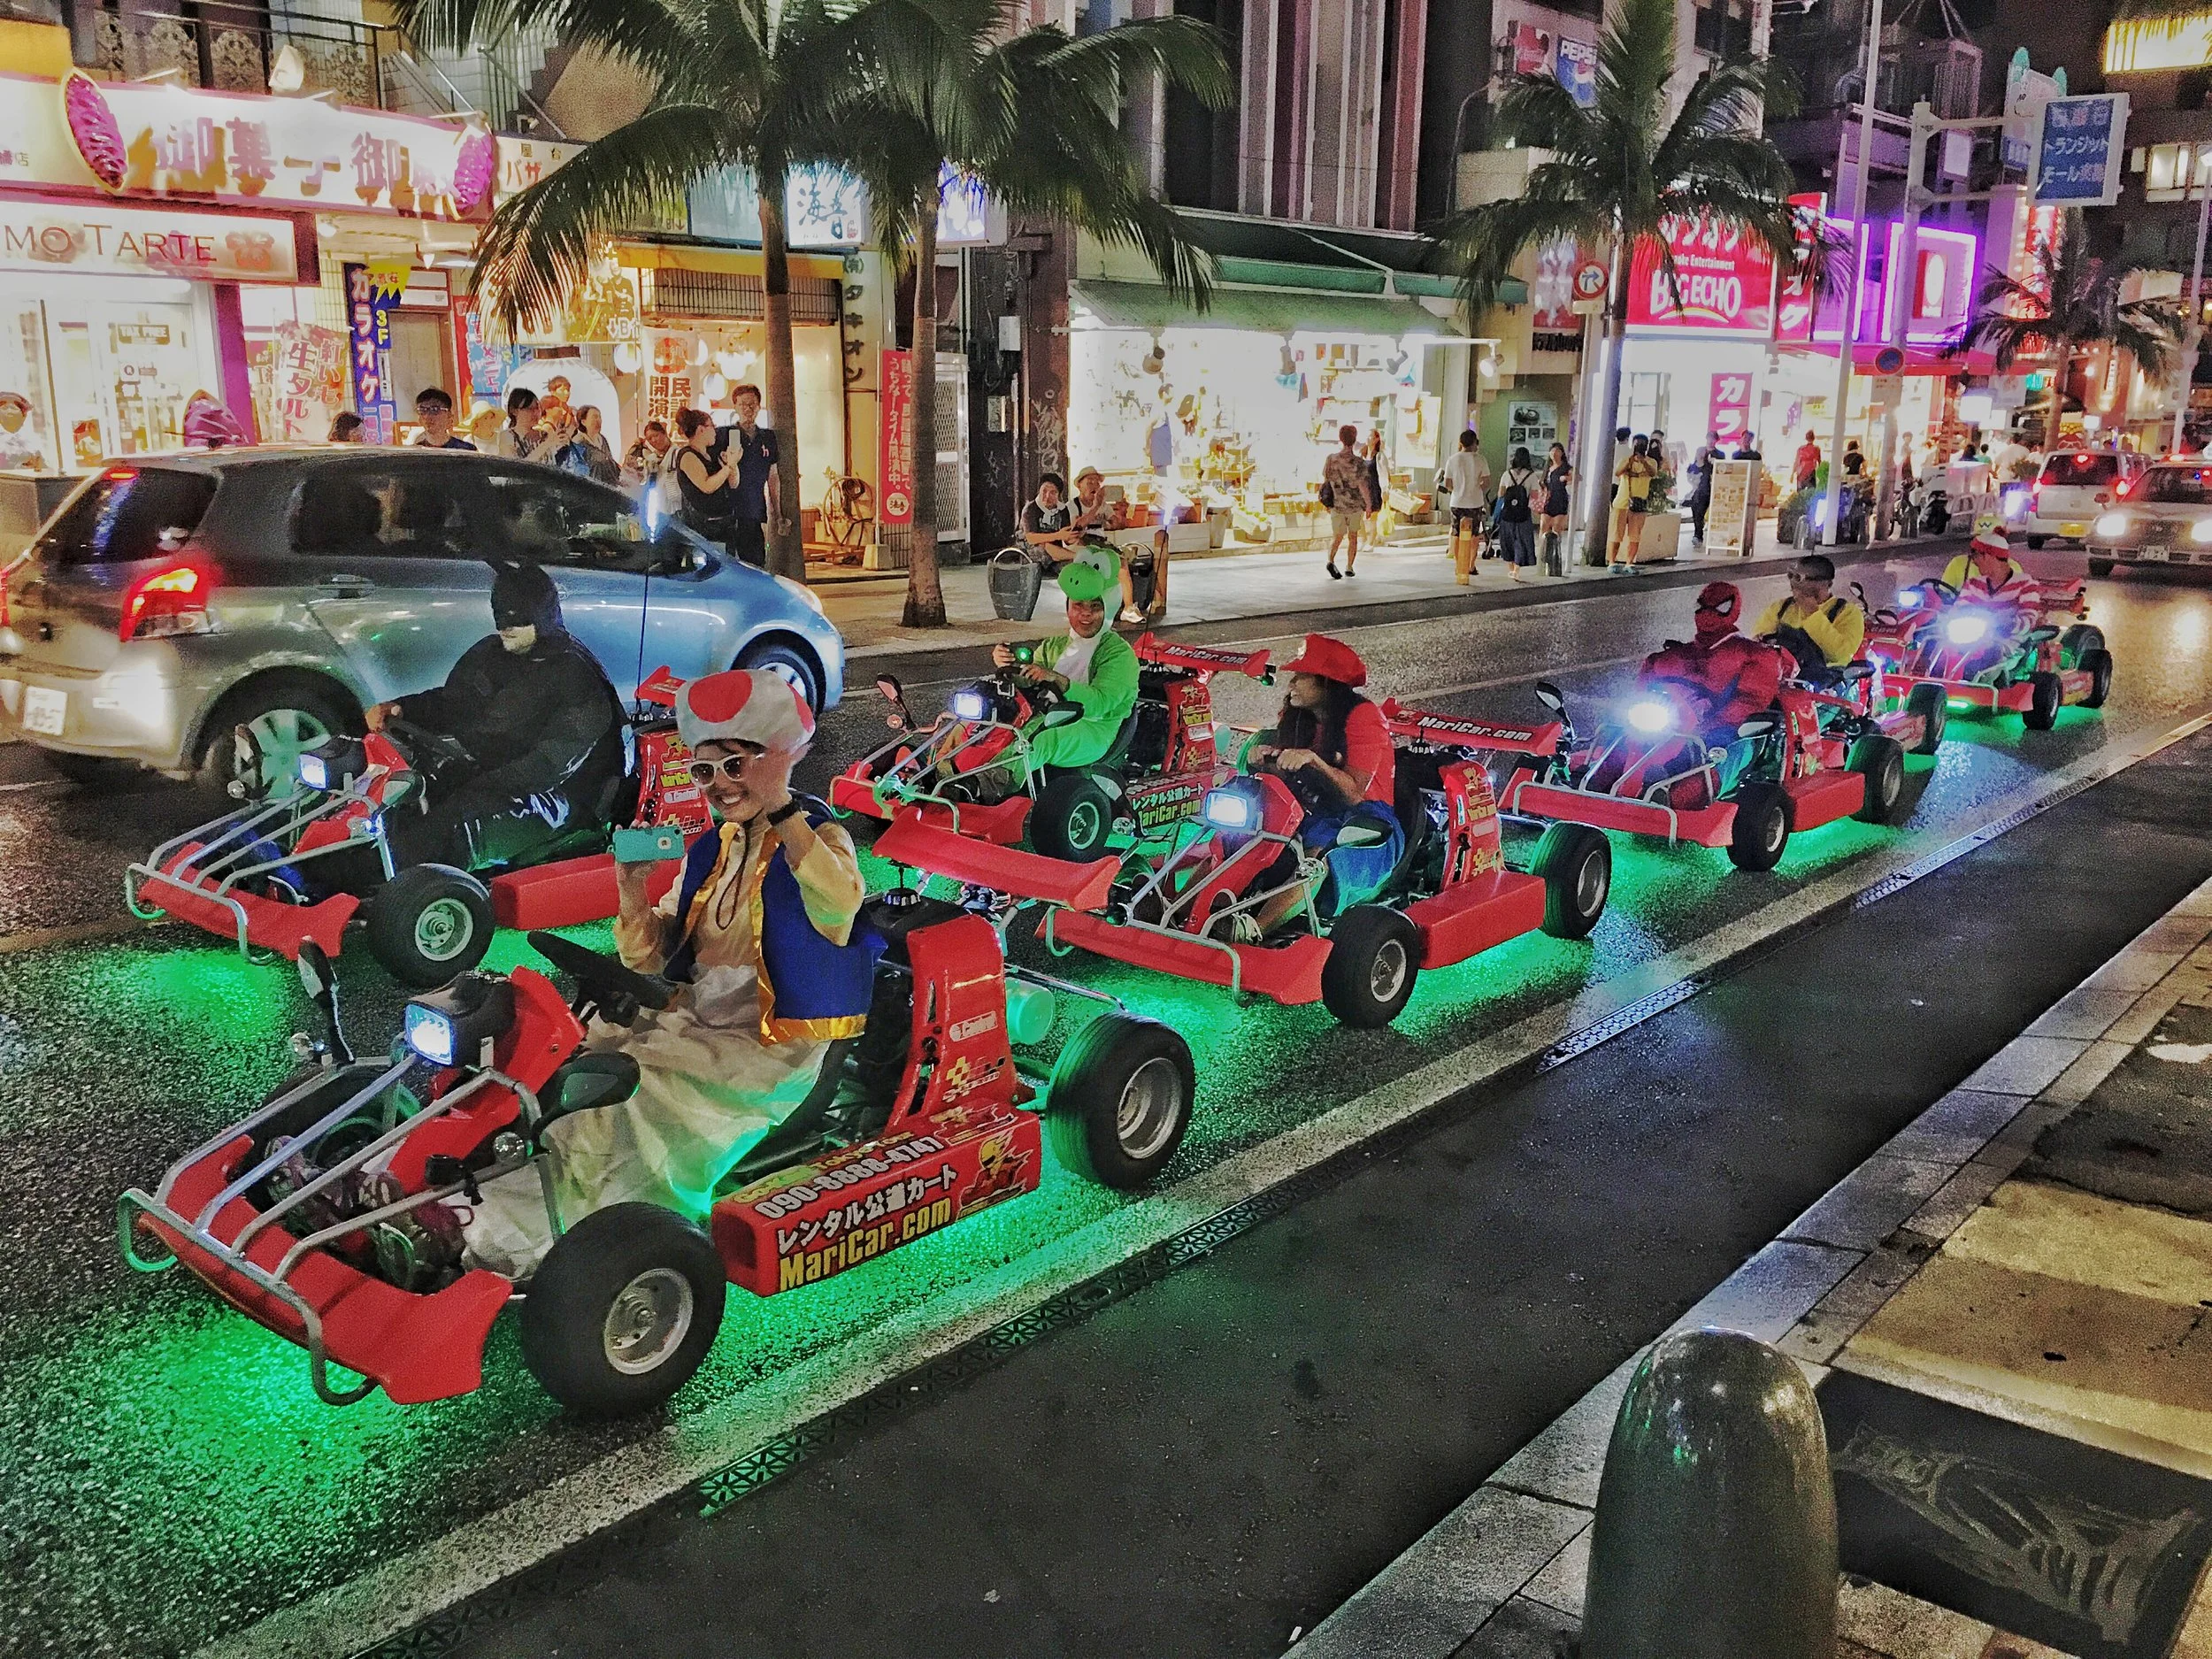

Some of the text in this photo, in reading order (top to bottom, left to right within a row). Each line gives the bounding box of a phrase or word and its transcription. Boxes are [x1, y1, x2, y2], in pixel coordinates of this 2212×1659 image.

[83, 223, 218, 262] TARTE
[1690, 255, 1735, 271] Entertainment
[1650, 269, 1742, 319] BG ECHO
[350, 268, 380, 404] カラオケ
[375, 309, 389, 345] 3F
[1164, 646, 1248, 664] MariCar.com
[1417, 716, 1532, 741] MariCar.com
[1139, 800, 1202, 826] ariCar.com
[755, 1136, 945, 1219] 090-8888-4747
[778, 1164, 957, 1255] レンタル公道カート
[780, 1197, 952, 1292] MariCar.com
